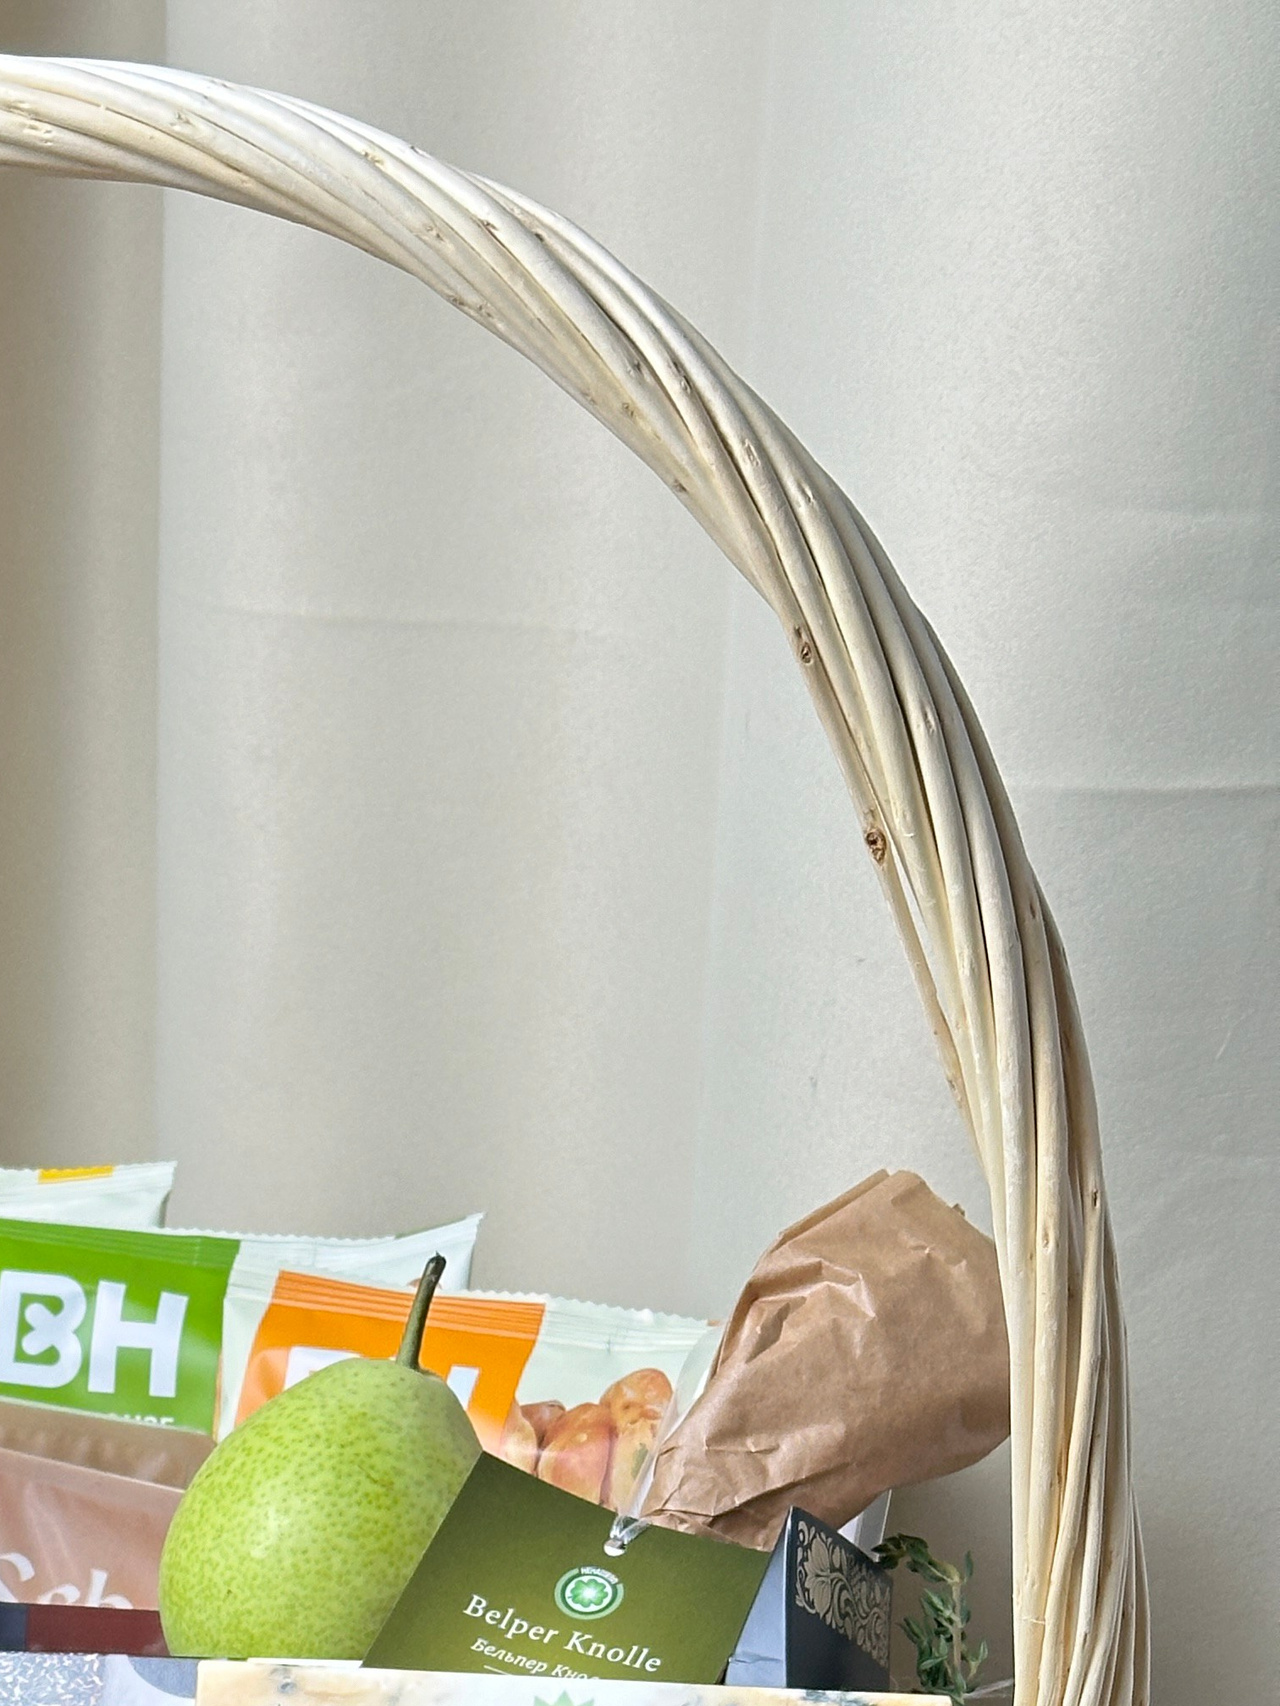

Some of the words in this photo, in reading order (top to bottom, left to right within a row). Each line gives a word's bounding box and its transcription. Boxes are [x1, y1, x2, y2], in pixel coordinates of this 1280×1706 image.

[463, 1594, 559, 1644] Belper
[564, 1630, 662, 1673] Knolle
[470, 1637, 548, 1674] Бельпер
